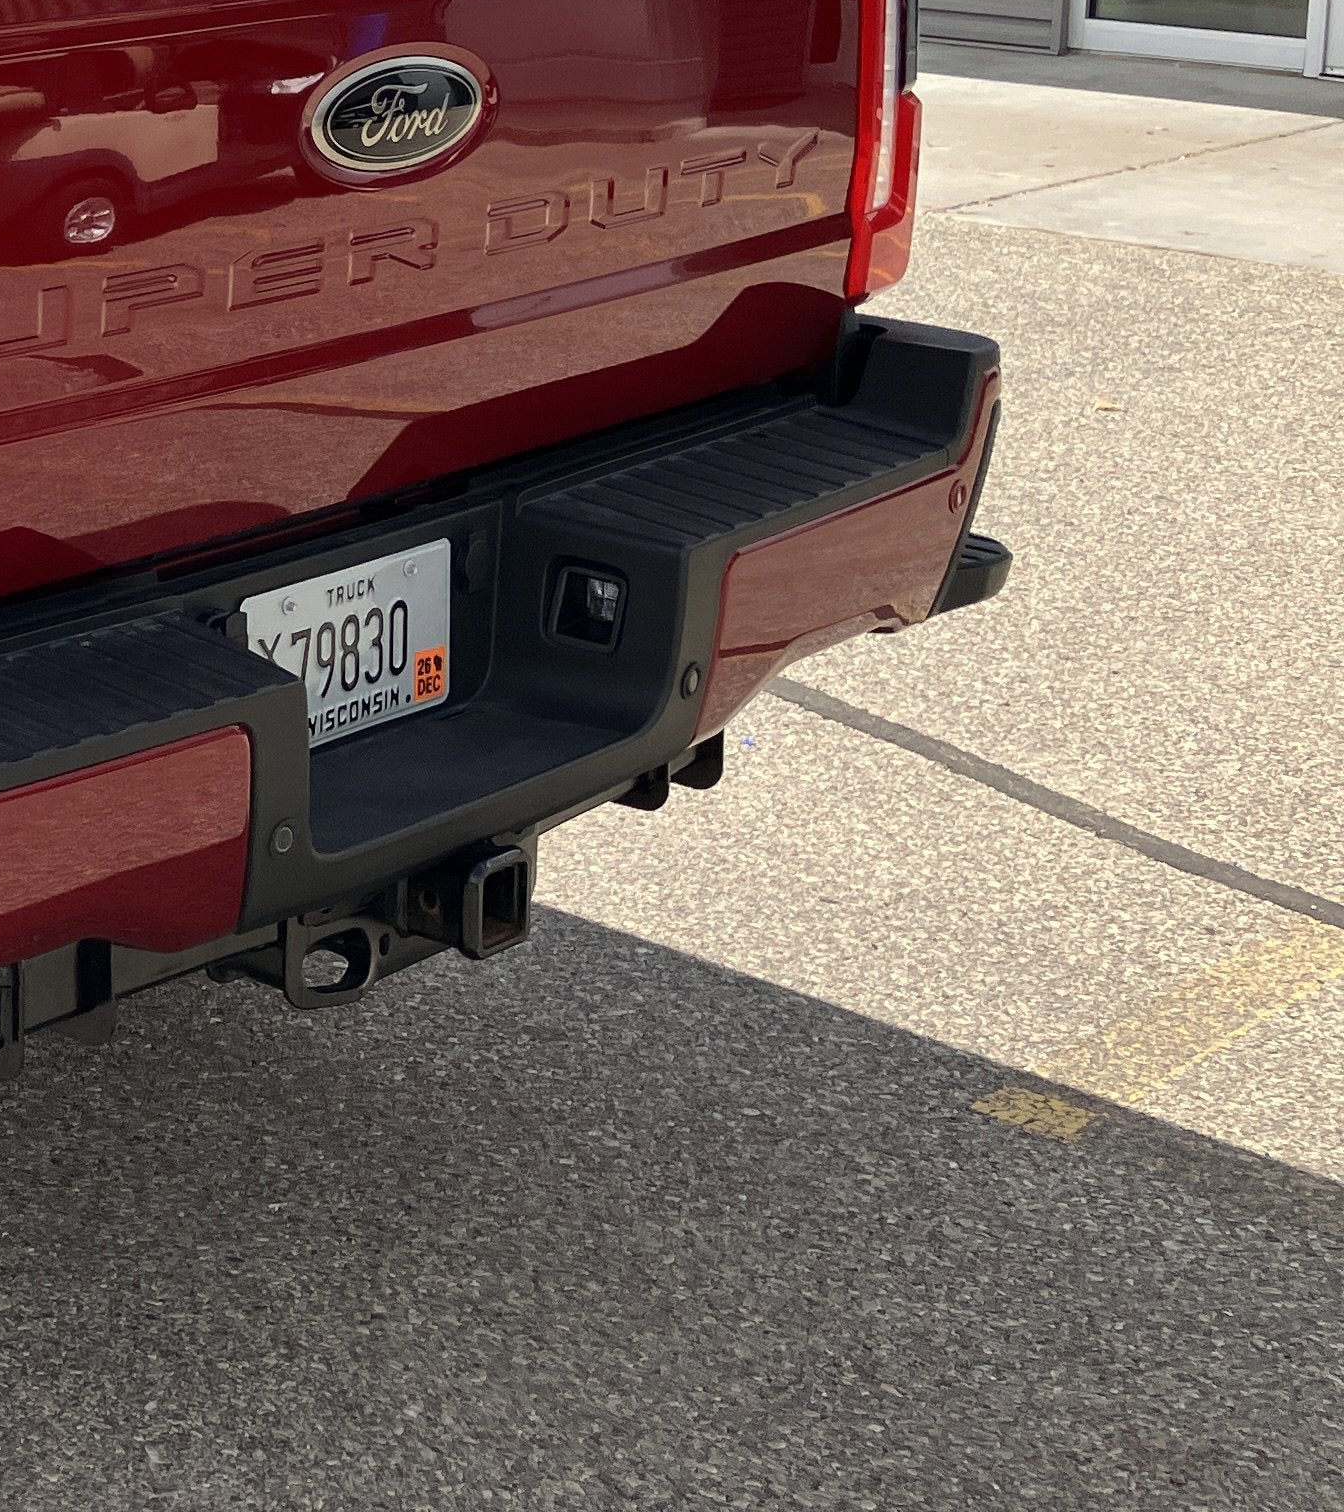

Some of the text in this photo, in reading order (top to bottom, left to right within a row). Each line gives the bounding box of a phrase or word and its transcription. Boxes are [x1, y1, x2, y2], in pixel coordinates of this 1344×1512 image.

[360, 83, 450, 147] Ford
[484, 127, 821, 256] DUTY
[327, 575, 377, 607] TRUCK
[417, 657, 431, 676] 26
[417, 674, 441, 696] DEC
